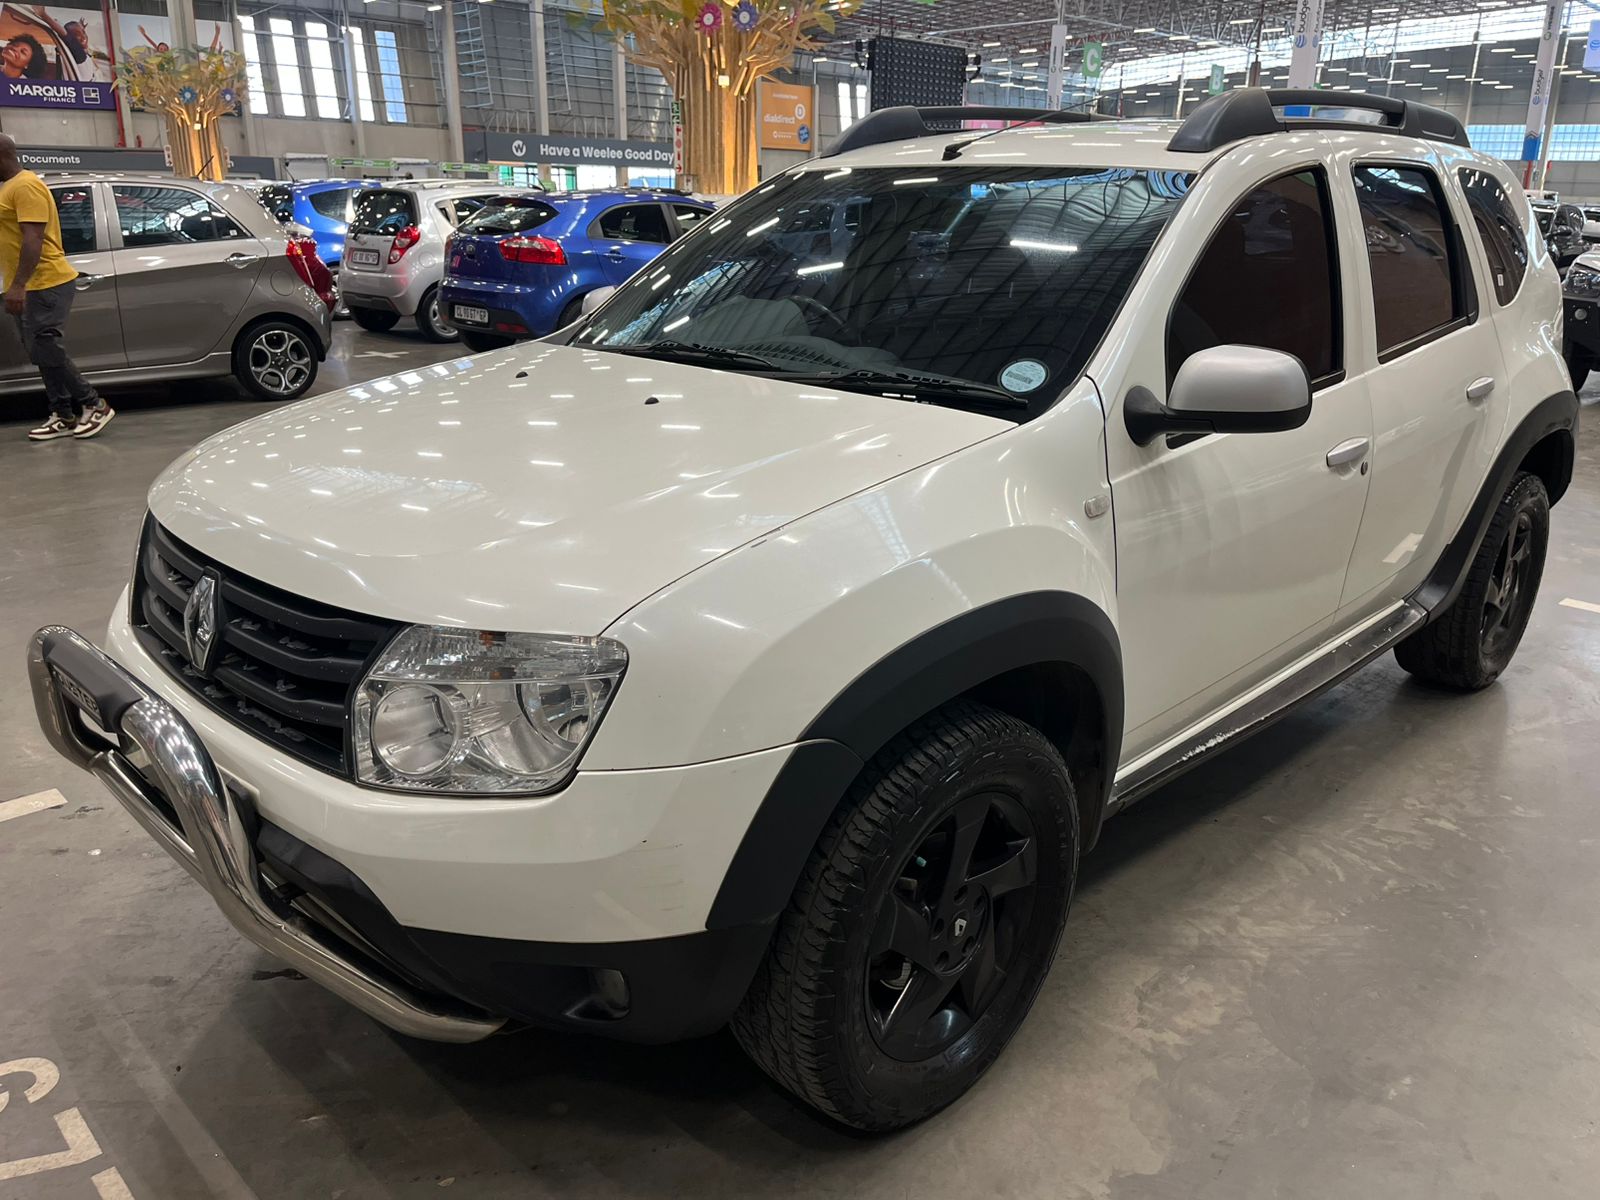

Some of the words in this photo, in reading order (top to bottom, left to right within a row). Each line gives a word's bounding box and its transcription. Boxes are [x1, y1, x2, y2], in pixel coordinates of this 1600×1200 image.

[1086, 47, 1100, 72] C
[9, 83, 76, 98] MARQUIS
[22, 154, 81, 164] Documents
[540, 144, 570, 156] Have
[572, 147, 580, 155] a
[582, 147, 623, 159] Weelee
[624, 149, 652, 161] Good
[654, 151, 674, 164] Day
